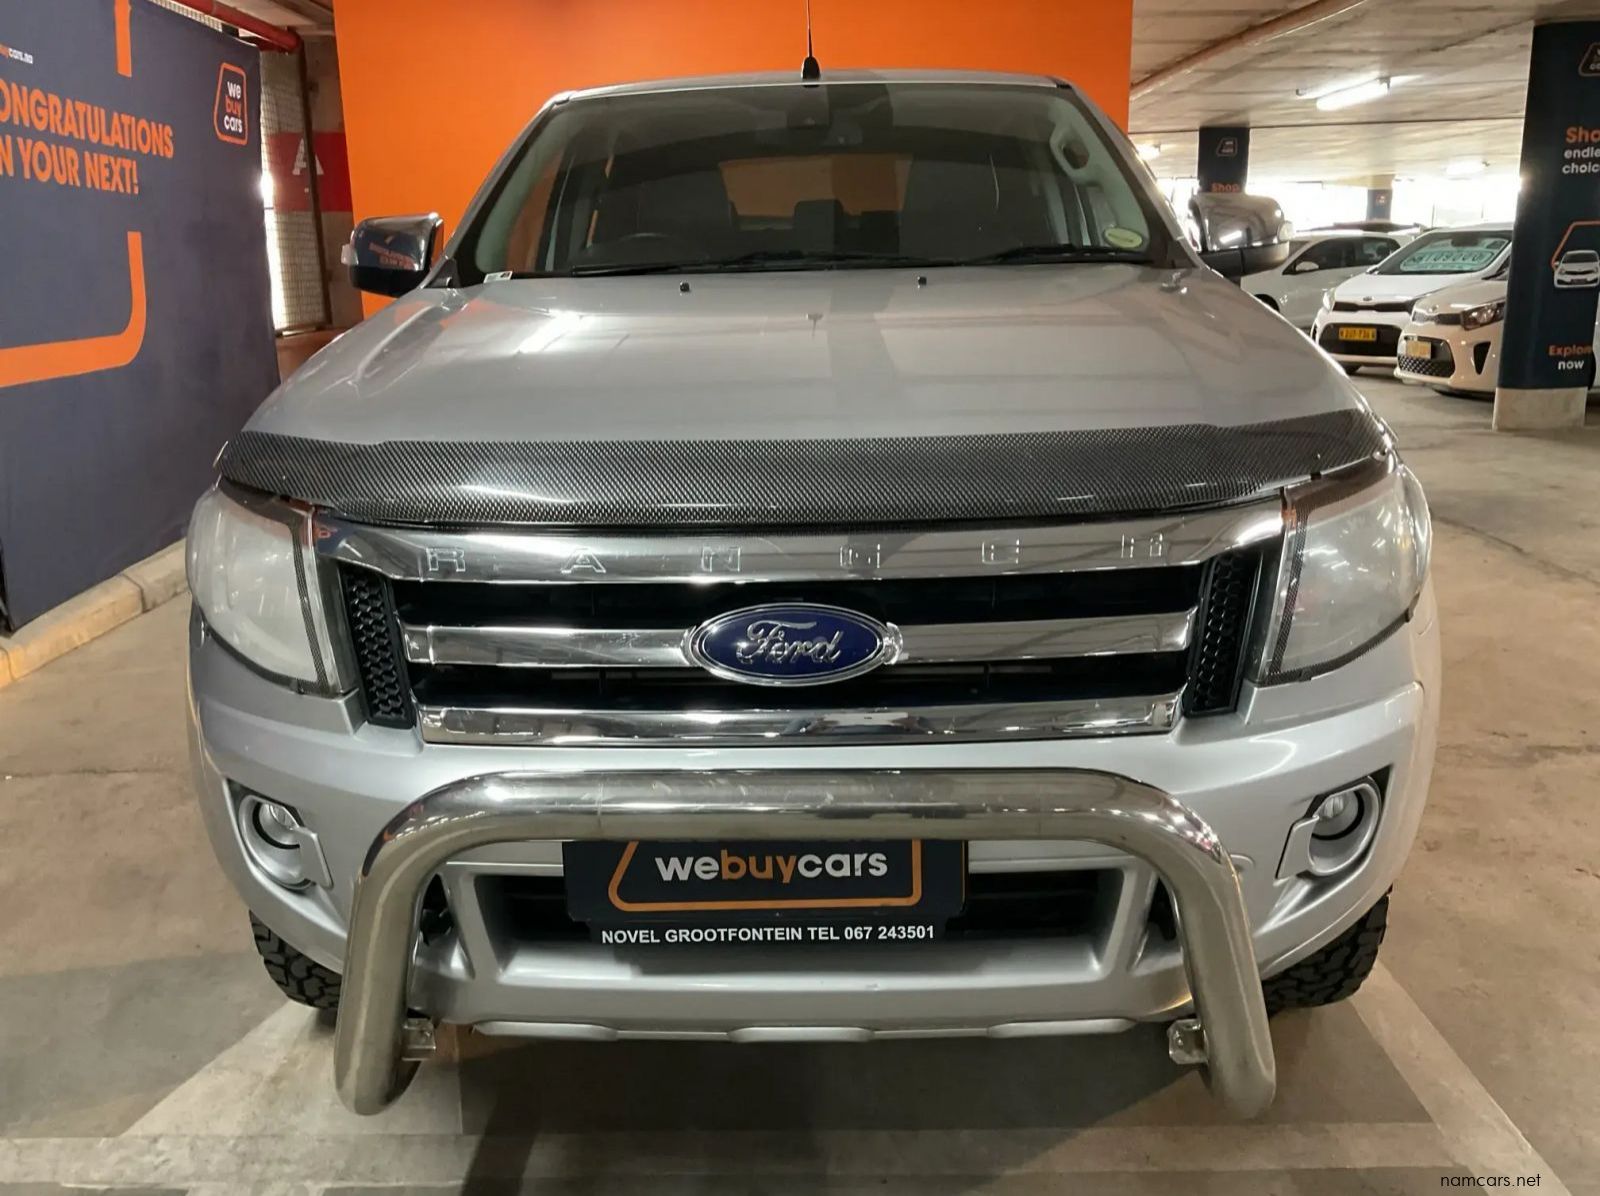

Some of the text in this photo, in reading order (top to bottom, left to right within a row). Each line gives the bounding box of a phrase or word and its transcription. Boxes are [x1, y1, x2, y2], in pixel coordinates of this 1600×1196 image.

[227, 81, 242, 99] we
[225, 95, 242, 117] buy
[223, 115, 243, 133] cars
[17, 137, 80, 187] YOUR
[84, 151, 139, 194] NEXT!
[1558, 360, 1584, 370] now
[736, 620, 844, 663] Ford
[655, 849, 888, 883] webuycars
[602, 925, 935, 944] NOVEL GROOTFONTEIN TEL 067 243501
